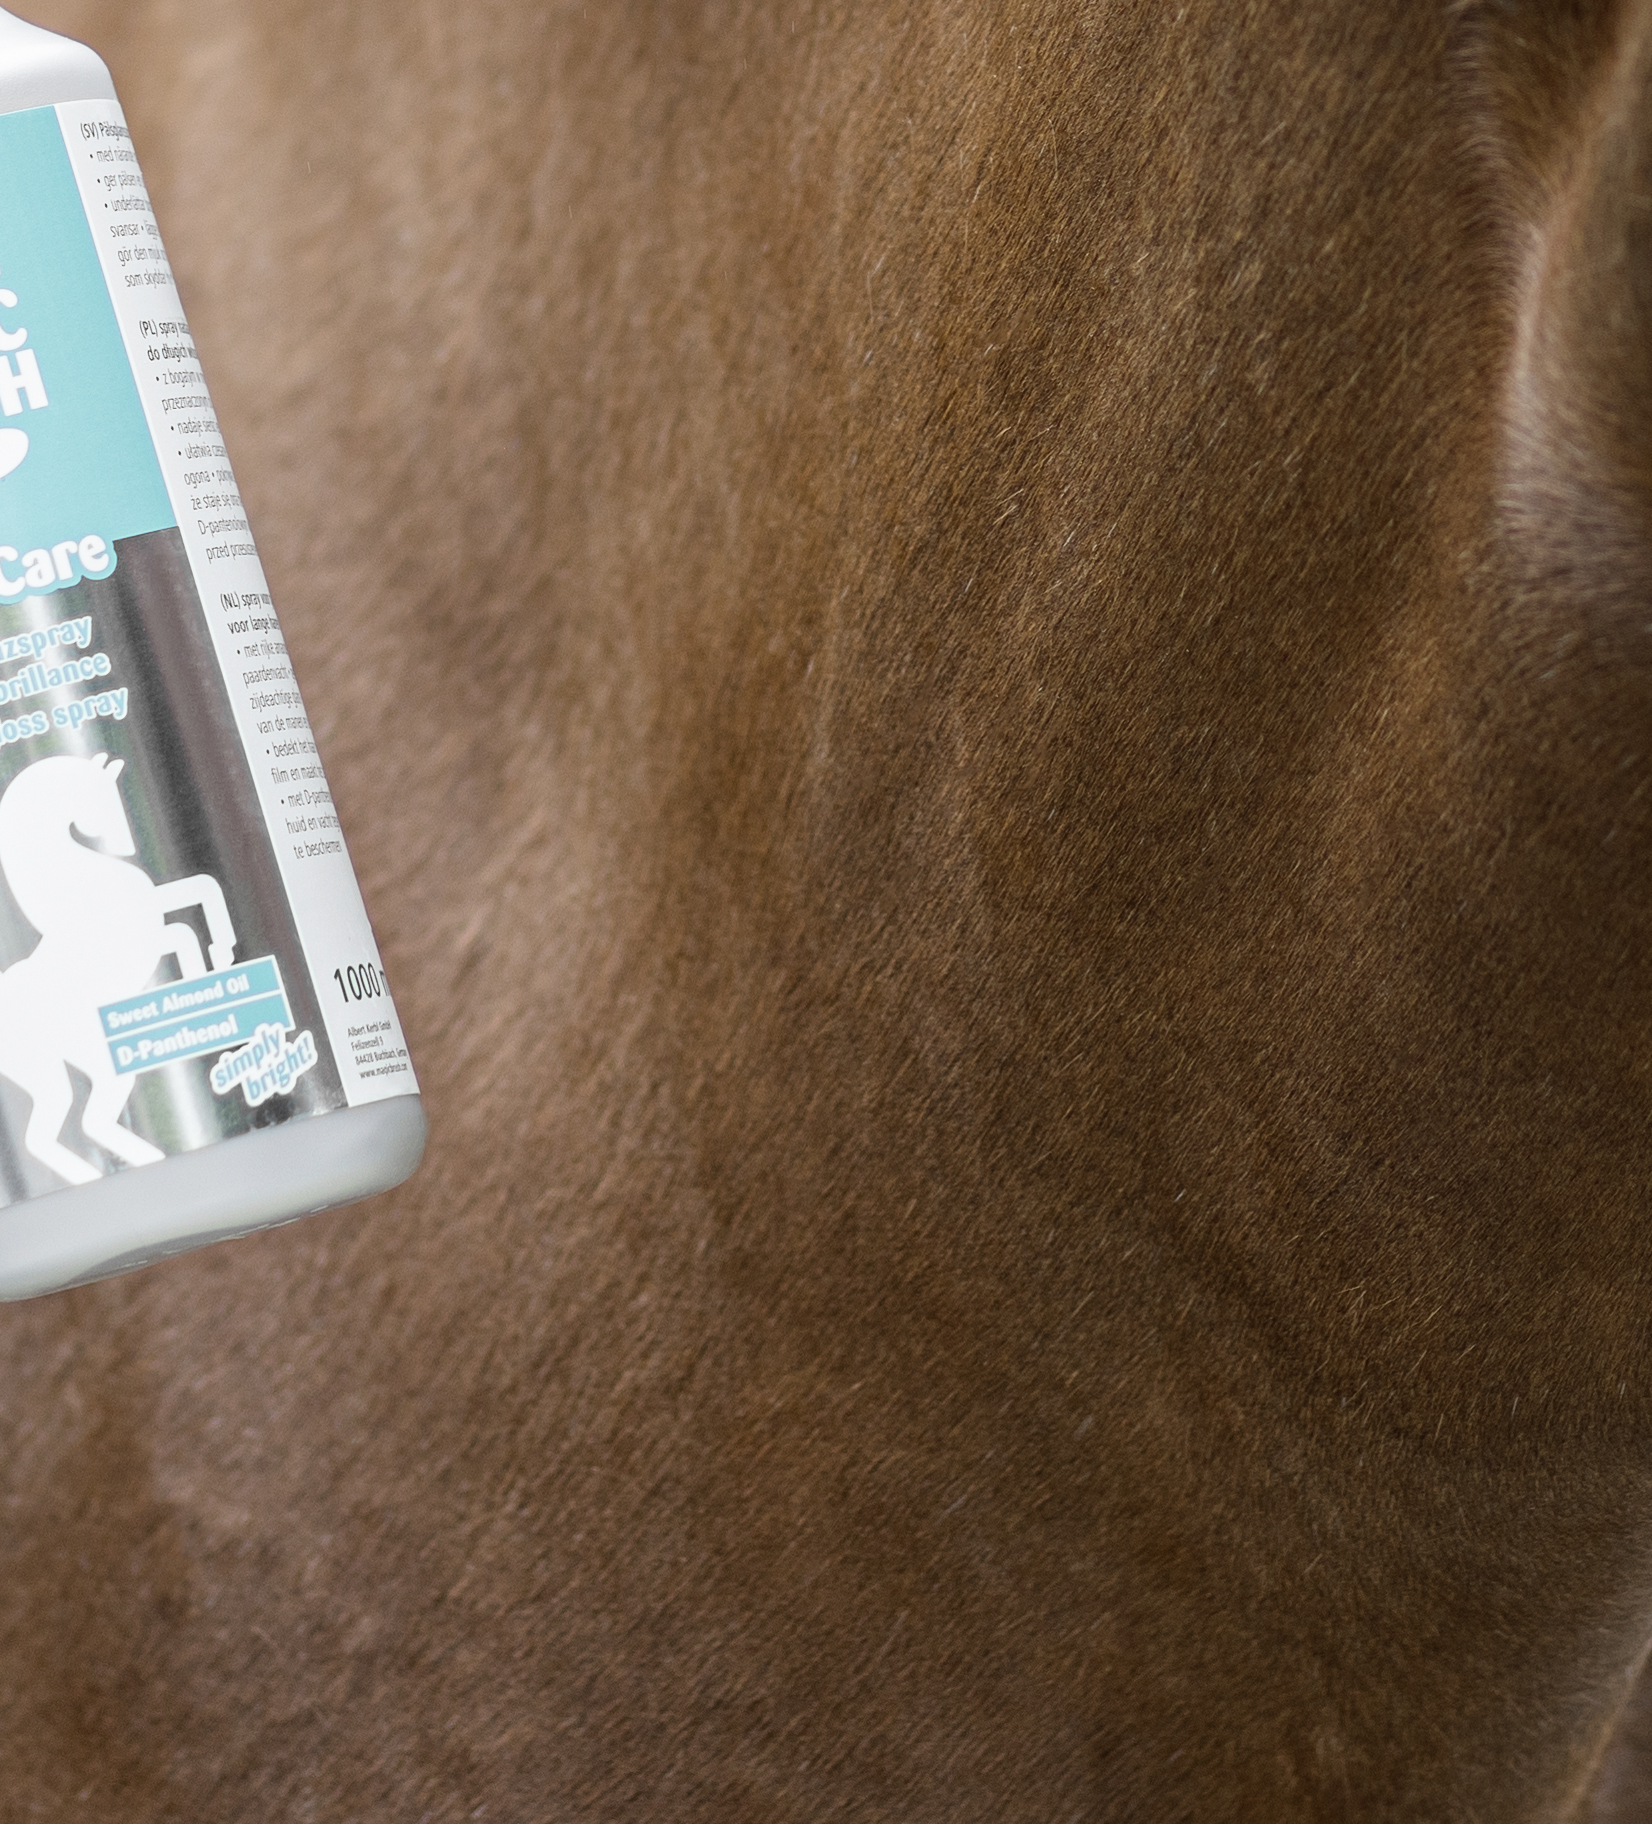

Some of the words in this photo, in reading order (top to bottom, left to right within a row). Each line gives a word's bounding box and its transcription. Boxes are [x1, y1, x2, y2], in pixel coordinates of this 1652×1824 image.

[80, 122, 99, 140] (SV)
[139, 319, 158, 338] (PL)
[158, 322, 179, 337] spray
[147, 345, 160, 361] do
[220, 592, 240, 612] (NL)
[241, 593, 261, 610] spray
[227, 620, 249, 634] voor
[52, 688, 127, 729] spray
[256, 720, 274, 734] van
[287, 791, 305, 807] met
[285, 815, 307, 834] huid
[334, 962, 381, 1002] 1000
[106, 1001, 159, 1029] Sweet
[162, 980, 224, 1014] Almond
[226, 973, 250, 995] Oil
[116, 1013, 239, 1067] D-Panthenol
[213, 1027, 283, 1088] simply
[245, 1035, 314, 1100] bright!
